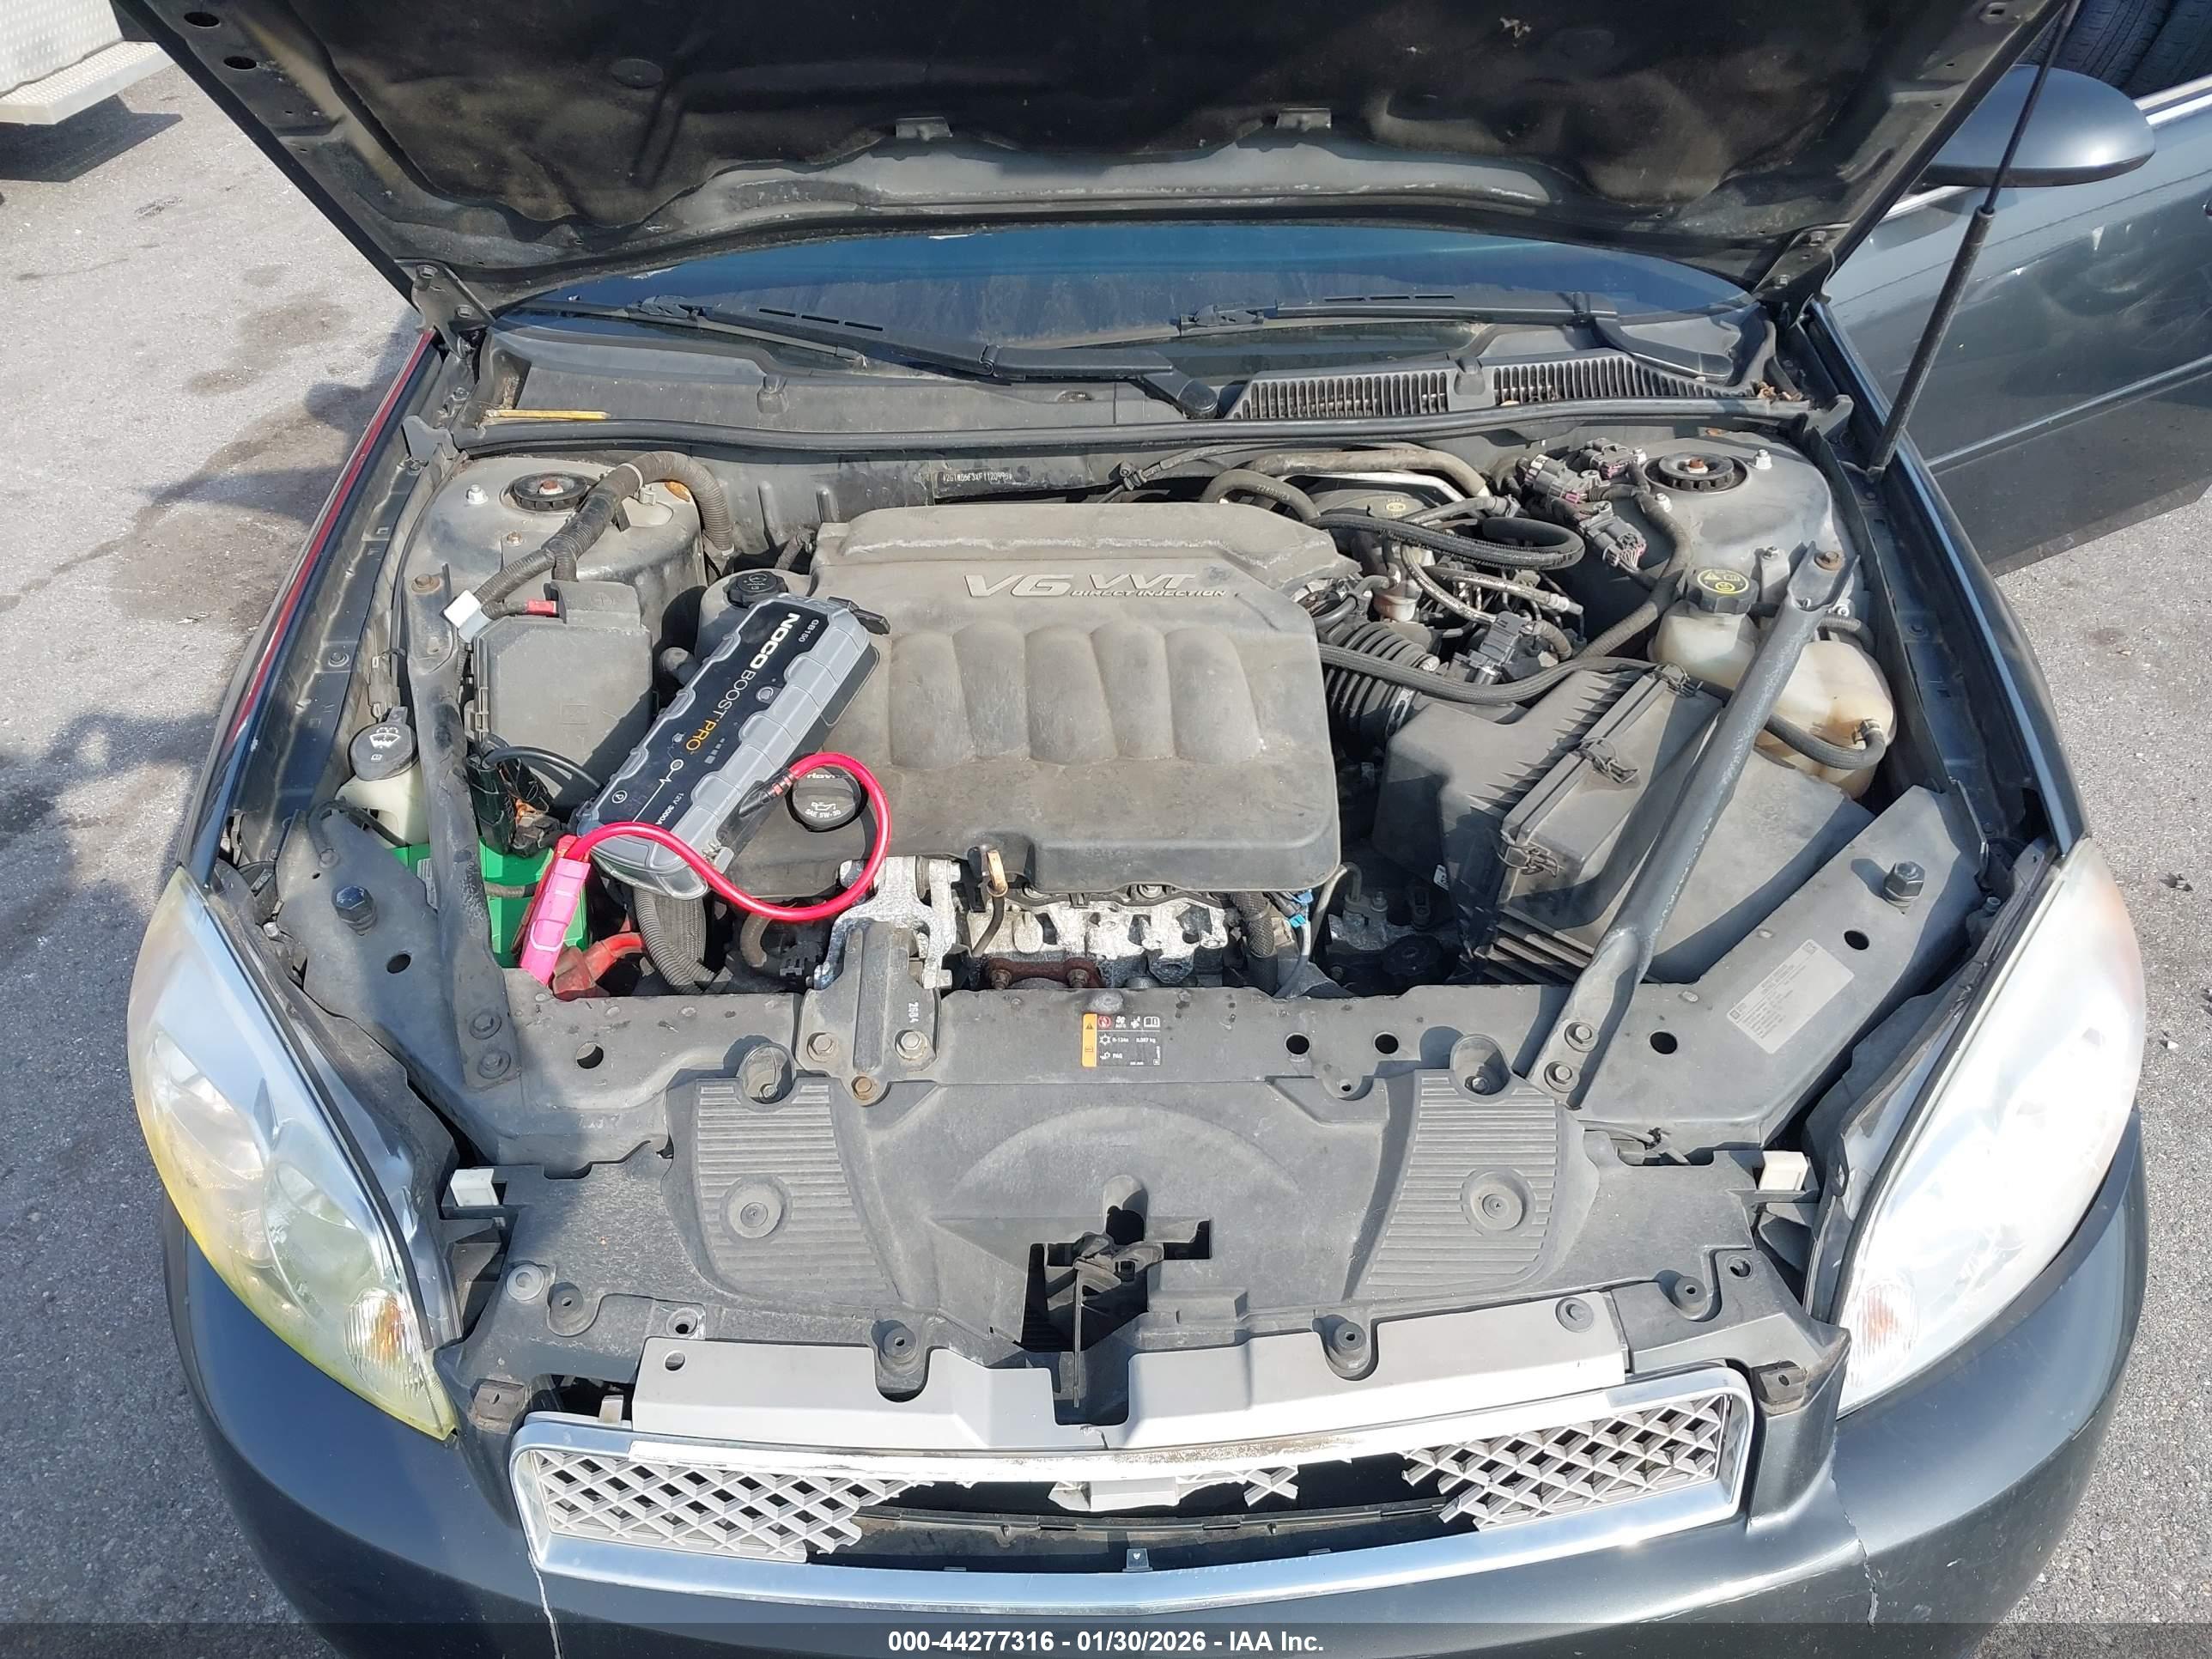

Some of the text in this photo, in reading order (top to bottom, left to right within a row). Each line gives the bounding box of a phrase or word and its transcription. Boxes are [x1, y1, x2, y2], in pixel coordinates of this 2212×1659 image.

[964, 574, 1074, 598] V6
[1070, 589, 1226, 598] DIRECT INJECTION
[1089, 574, 1196, 590] VVT
[798, 619, 819, 642] GB150
[685, 612, 801, 750] NOCO BOOST PRO
[655, 793, 684, 825] 12V 3000A
[805, 808, 842, 818] SAE 5W-30
